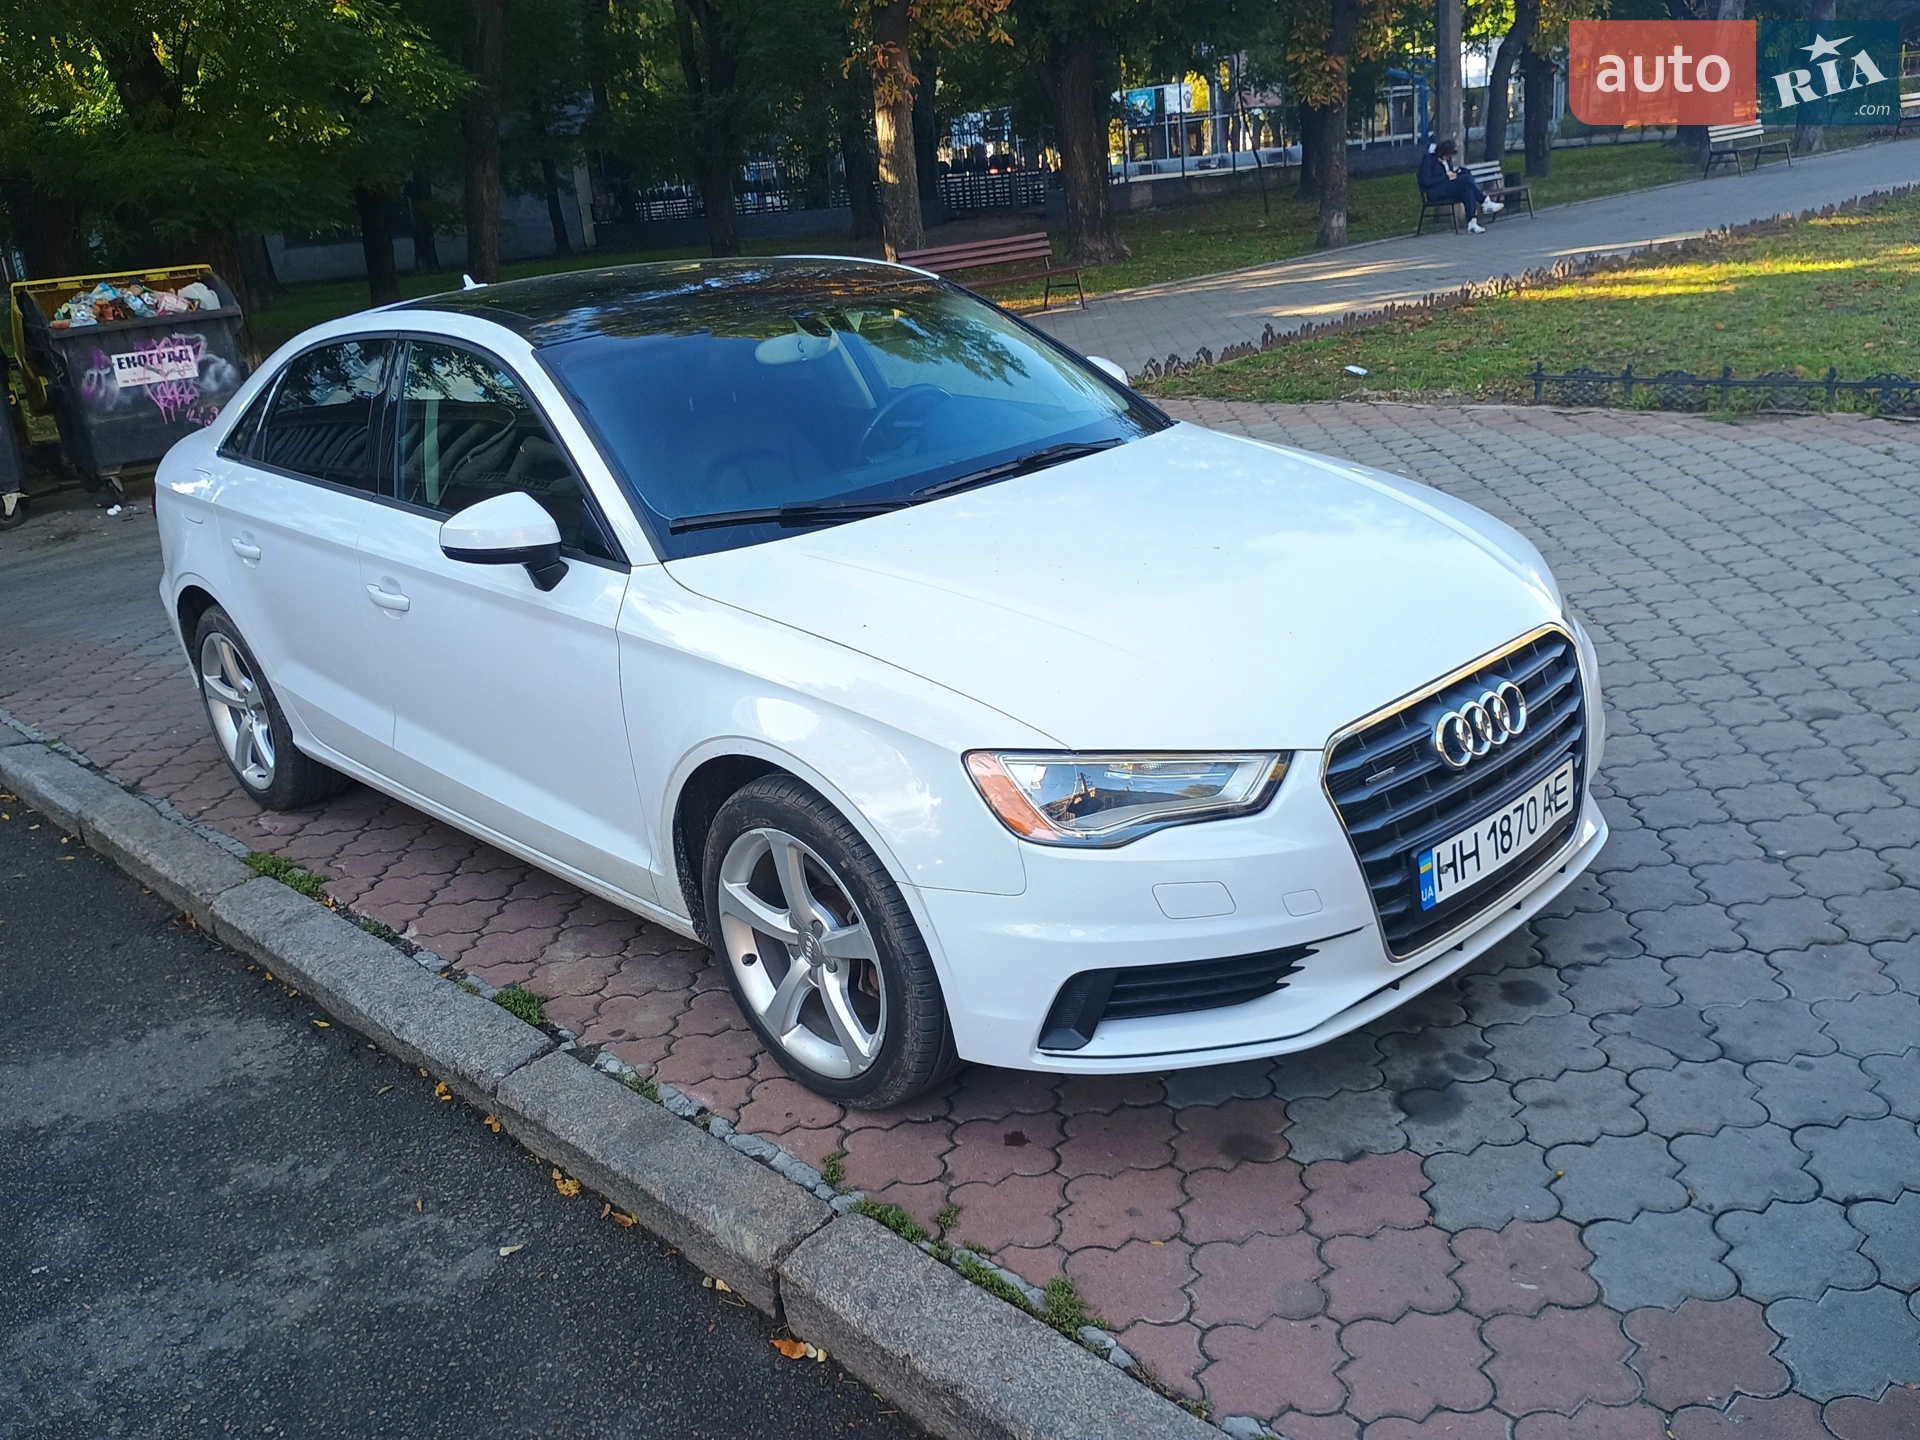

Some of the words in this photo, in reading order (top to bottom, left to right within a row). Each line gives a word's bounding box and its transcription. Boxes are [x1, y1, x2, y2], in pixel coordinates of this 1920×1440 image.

[1436, 831, 1481, 892] HH
[1487, 795, 1538, 861] 1870
[1542, 769, 1569, 826] AE
[1421, 886, 1434, 902] UA
